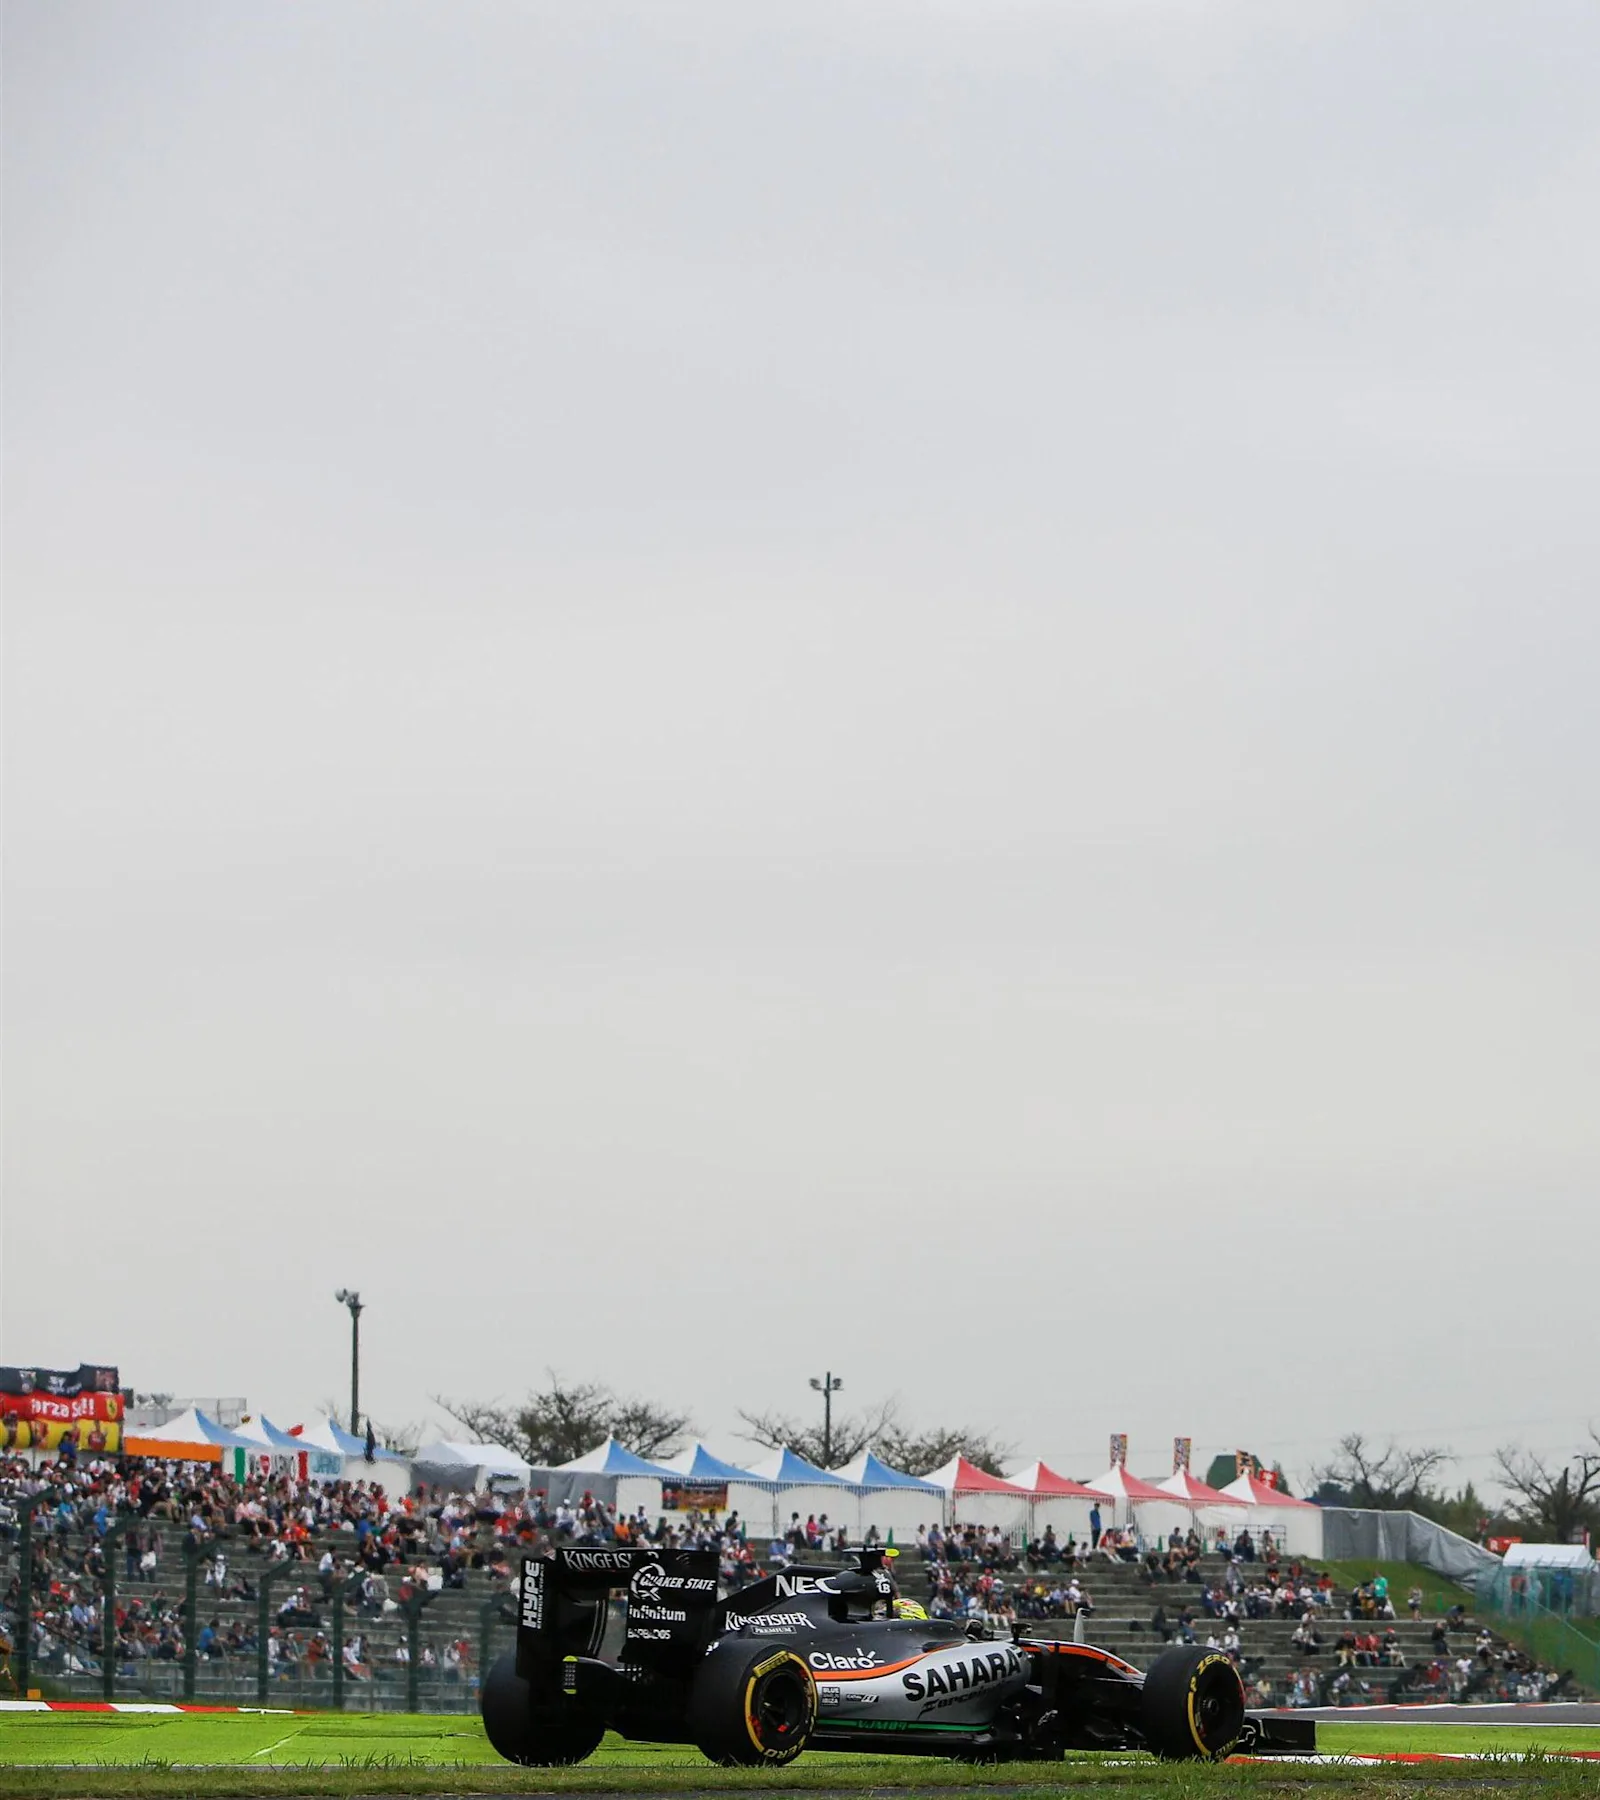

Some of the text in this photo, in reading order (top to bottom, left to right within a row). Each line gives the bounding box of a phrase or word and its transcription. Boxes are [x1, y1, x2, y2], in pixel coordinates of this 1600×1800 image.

[640, 1573, 716, 1591] QUAKER STATE
[774, 1575, 841, 1597] NEC
[522, 1560, 540, 1629] HYPE
[629, 1604, 686, 1622] infinitum
[725, 1611, 817, 1630] KINGFISHER
[808, 1650, 878, 1670] Claro
[1197, 1654, 1231, 1676] ZERO
[902, 1646, 1022, 1702] SAHARA
